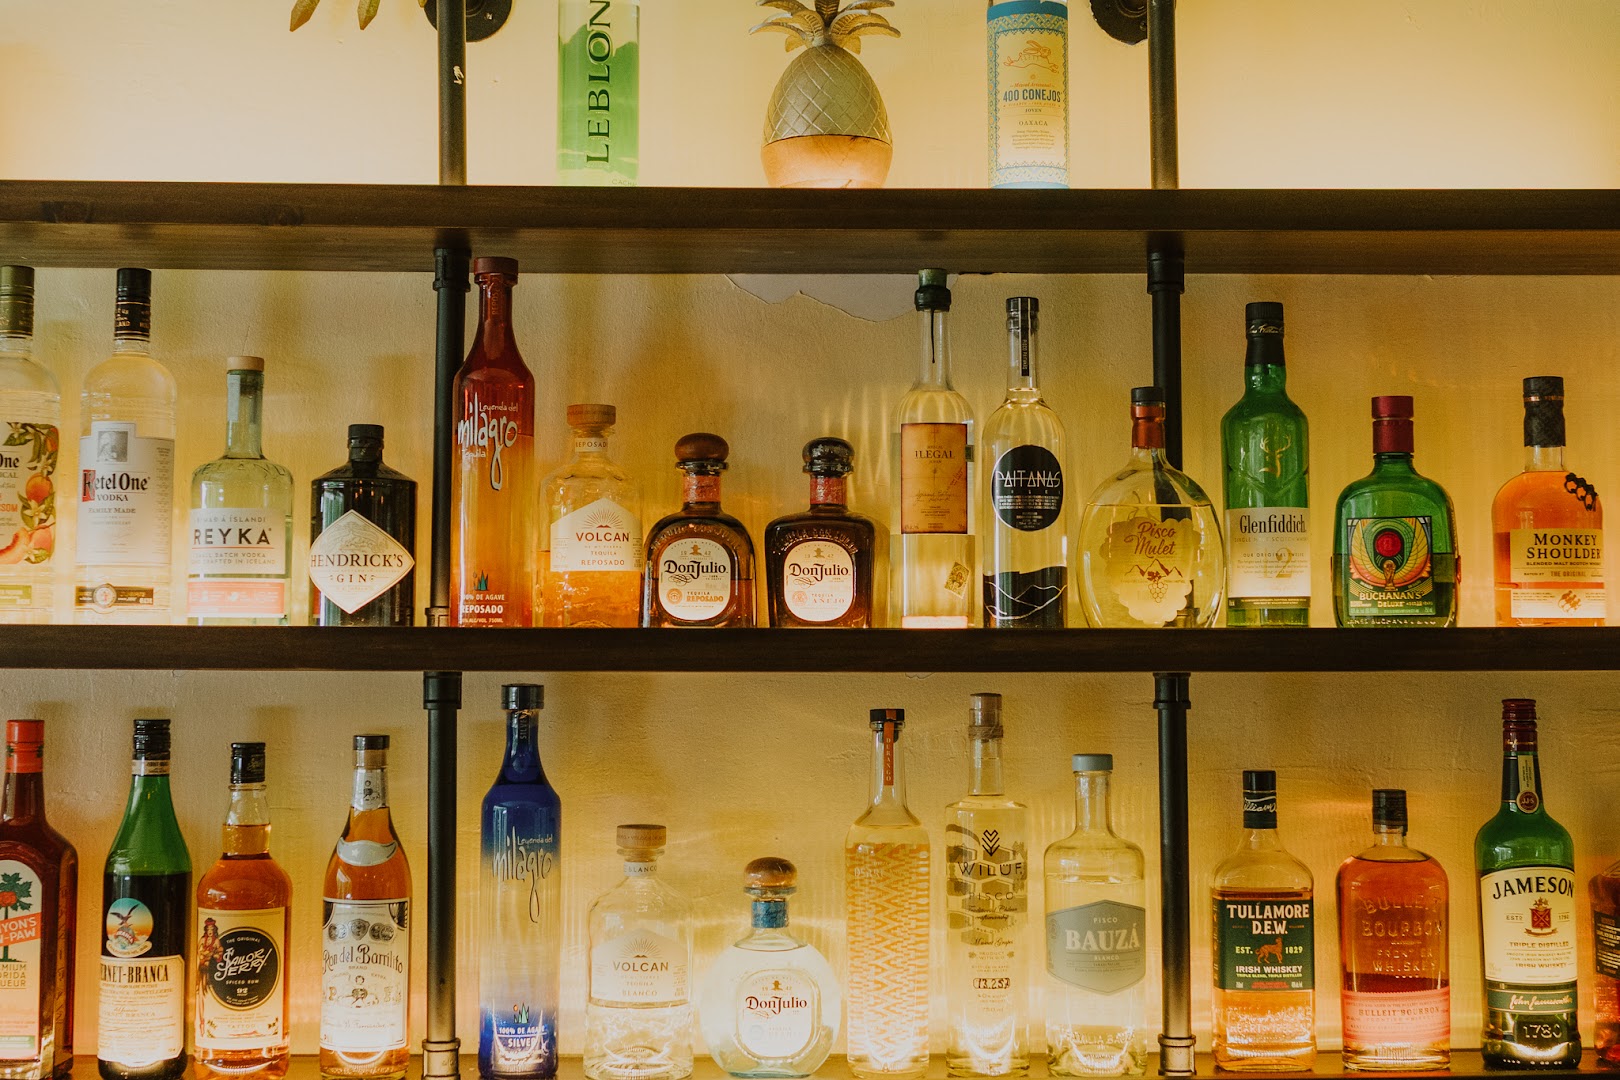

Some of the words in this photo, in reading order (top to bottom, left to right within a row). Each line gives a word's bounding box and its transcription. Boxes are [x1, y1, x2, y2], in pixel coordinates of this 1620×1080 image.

[586, 0, 611, 163] LEBLON
[1003, 89, 1020, 102] 400
[1022, 88, 1061, 103] CONEJOS
[457, 391, 519, 492] milagro
[914, 450, 955, 460] ILEGAL
[82, 469, 117, 502] Ketel
[118, 472, 149, 491] One
[97, 494, 129, 502] VODKA
[1137, 521, 1177, 540] Pisco
[1240, 514, 1307, 534] Glenfiddich
[193, 528, 271, 545] REYKA
[576, 532, 630, 543] VOLCAN
[1533, 533, 1597, 546] MONKEY
[1123, 534, 1177, 559] Mulet
[1526, 546, 1601, 559] SHOULDER
[310, 553, 404, 569] HENDRICK'S
[336, 573, 368, 584] GIN
[1359, 591, 1423, 601] BUCHANAN'S
[491, 825, 553, 924] milagro
[1492, 876, 1574, 900] JAMESON
[968, 892, 1014, 901] PISCO
[1226, 903, 1310, 919] TULLAMORE
[1252, 920, 1288, 935] D.E.W.
[237, 935, 261, 943] ORIGINAL
[1064, 922, 1140, 951] BAUZÁ
[1235, 946, 1253, 954] EST.
[1285, 946, 1303, 954] 1829
[1538, 940, 1569, 948] DISTILLED
[322, 949, 338, 975] Ron
[339, 946, 354, 963] del
[355, 944, 403, 974] Barrilito
[612, 961, 669, 972] VOLCAN
[1236, 965, 1261, 974] IRISH
[1263, 965, 1303, 974] WHISKEY
[1359, 1008, 1397, 1017] BULLEIT
[1400, 1006, 1440, 1017] BOURBON
[517, 1026, 526, 1034] DE
